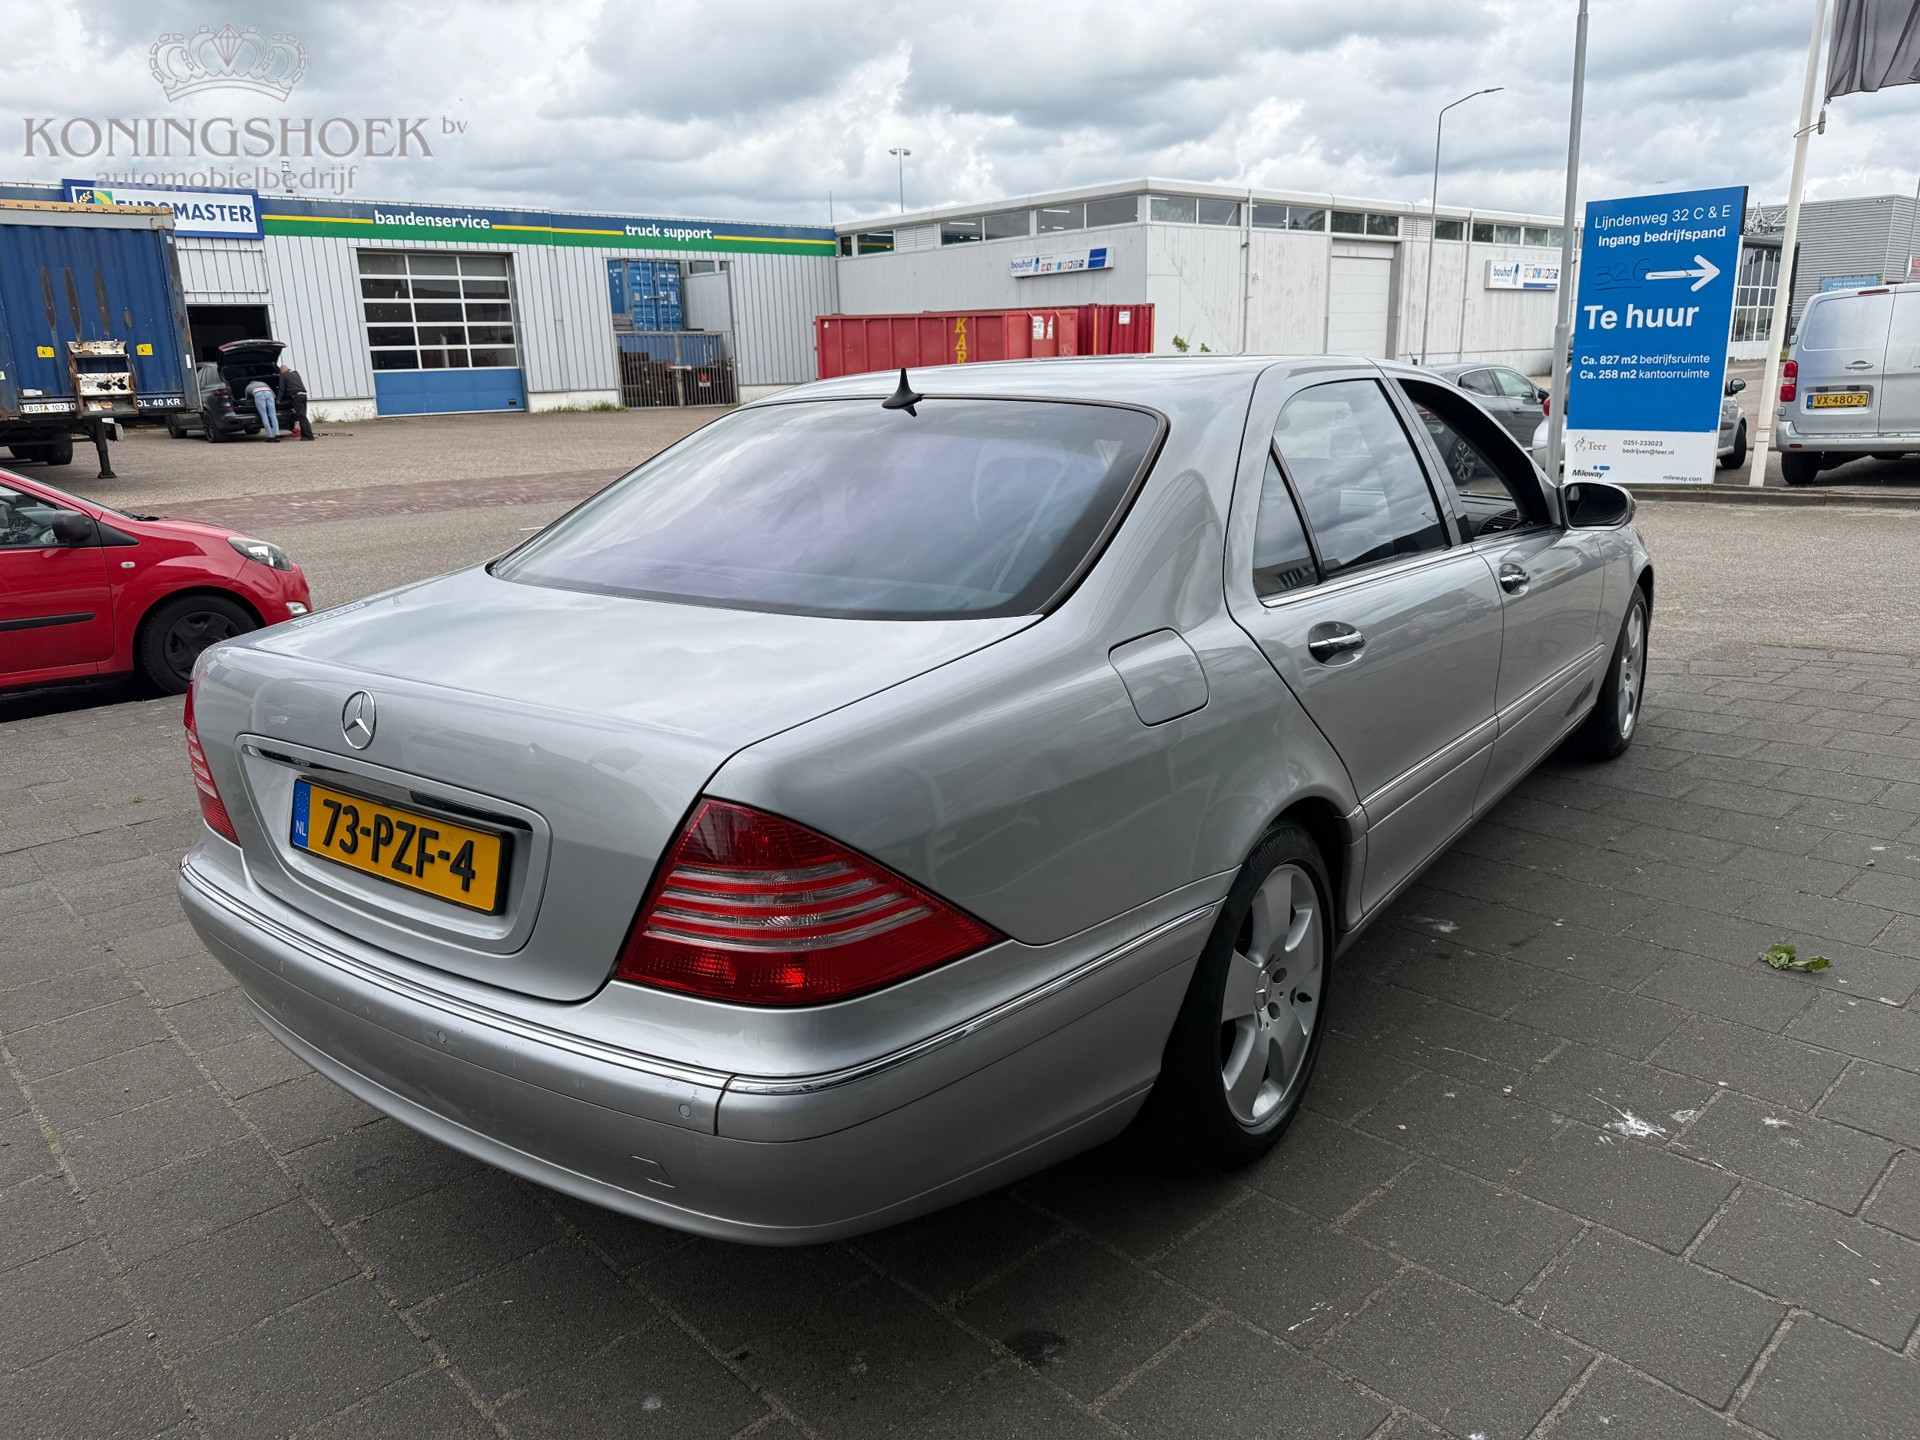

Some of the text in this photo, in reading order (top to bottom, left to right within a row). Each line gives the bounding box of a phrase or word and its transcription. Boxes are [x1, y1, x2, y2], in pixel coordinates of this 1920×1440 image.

[115, 200, 253, 223] MASTER
[1594, 205, 1731, 231] Lijndenweg 32 C & E
[374, 210, 490, 229] bandenservice
[625, 224, 712, 242] truck support
[1598, 226, 1726, 248] Ingang bedrijfspand
[1584, 303, 1700, 330] Te huur
[1581, 353, 1710, 366] Ca. 827 m2 bedrijfsruimte
[1580, 368, 1709, 379] Ca. 258 m2 kantoorruimte
[152, 399, 163, 407] 40
[166, 398, 181, 406] KR
[1816, 395, 1863, 405] VX-480-Z
[1587, 441, 1607, 451] Teer
[1623, 439, 1663, 447] 0251-233023
[1622, 448, 1674, 456] bedrijven@teer.nl
[1572, 469, 1604, 479] Mileway
[1662, 474, 1702, 482] mileway.com
[295, 819, 307, 837] NL
[322, 798, 476, 893] 73-PZF-4
